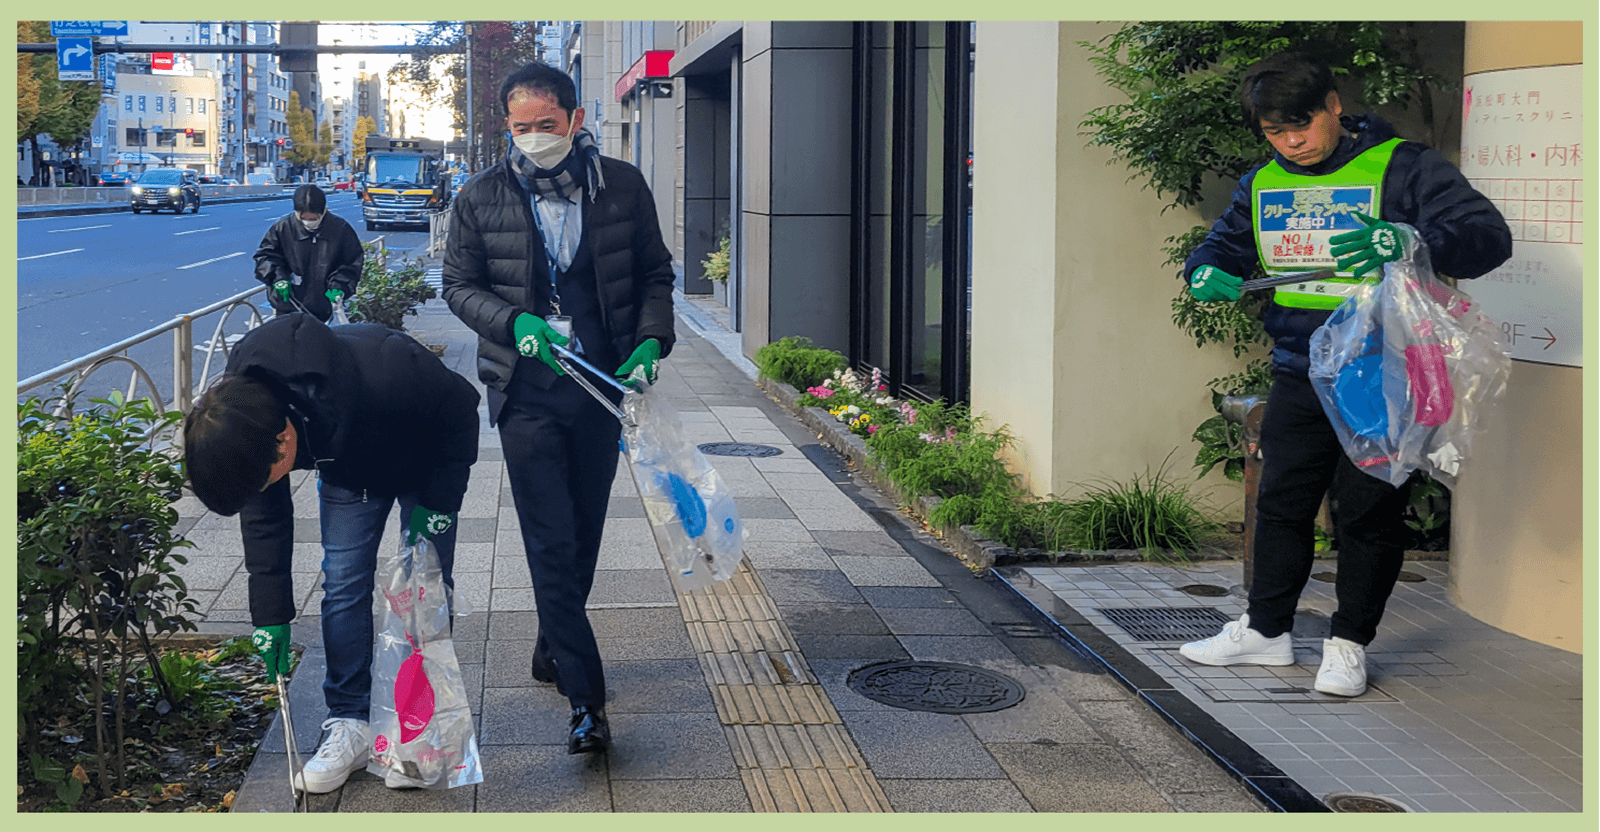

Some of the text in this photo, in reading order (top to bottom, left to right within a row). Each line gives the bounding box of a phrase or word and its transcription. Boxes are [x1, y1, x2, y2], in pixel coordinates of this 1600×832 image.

[1555, 184, 1566, 196] 金
[1263, 202, 1371, 218] クリーンキャンペーン
